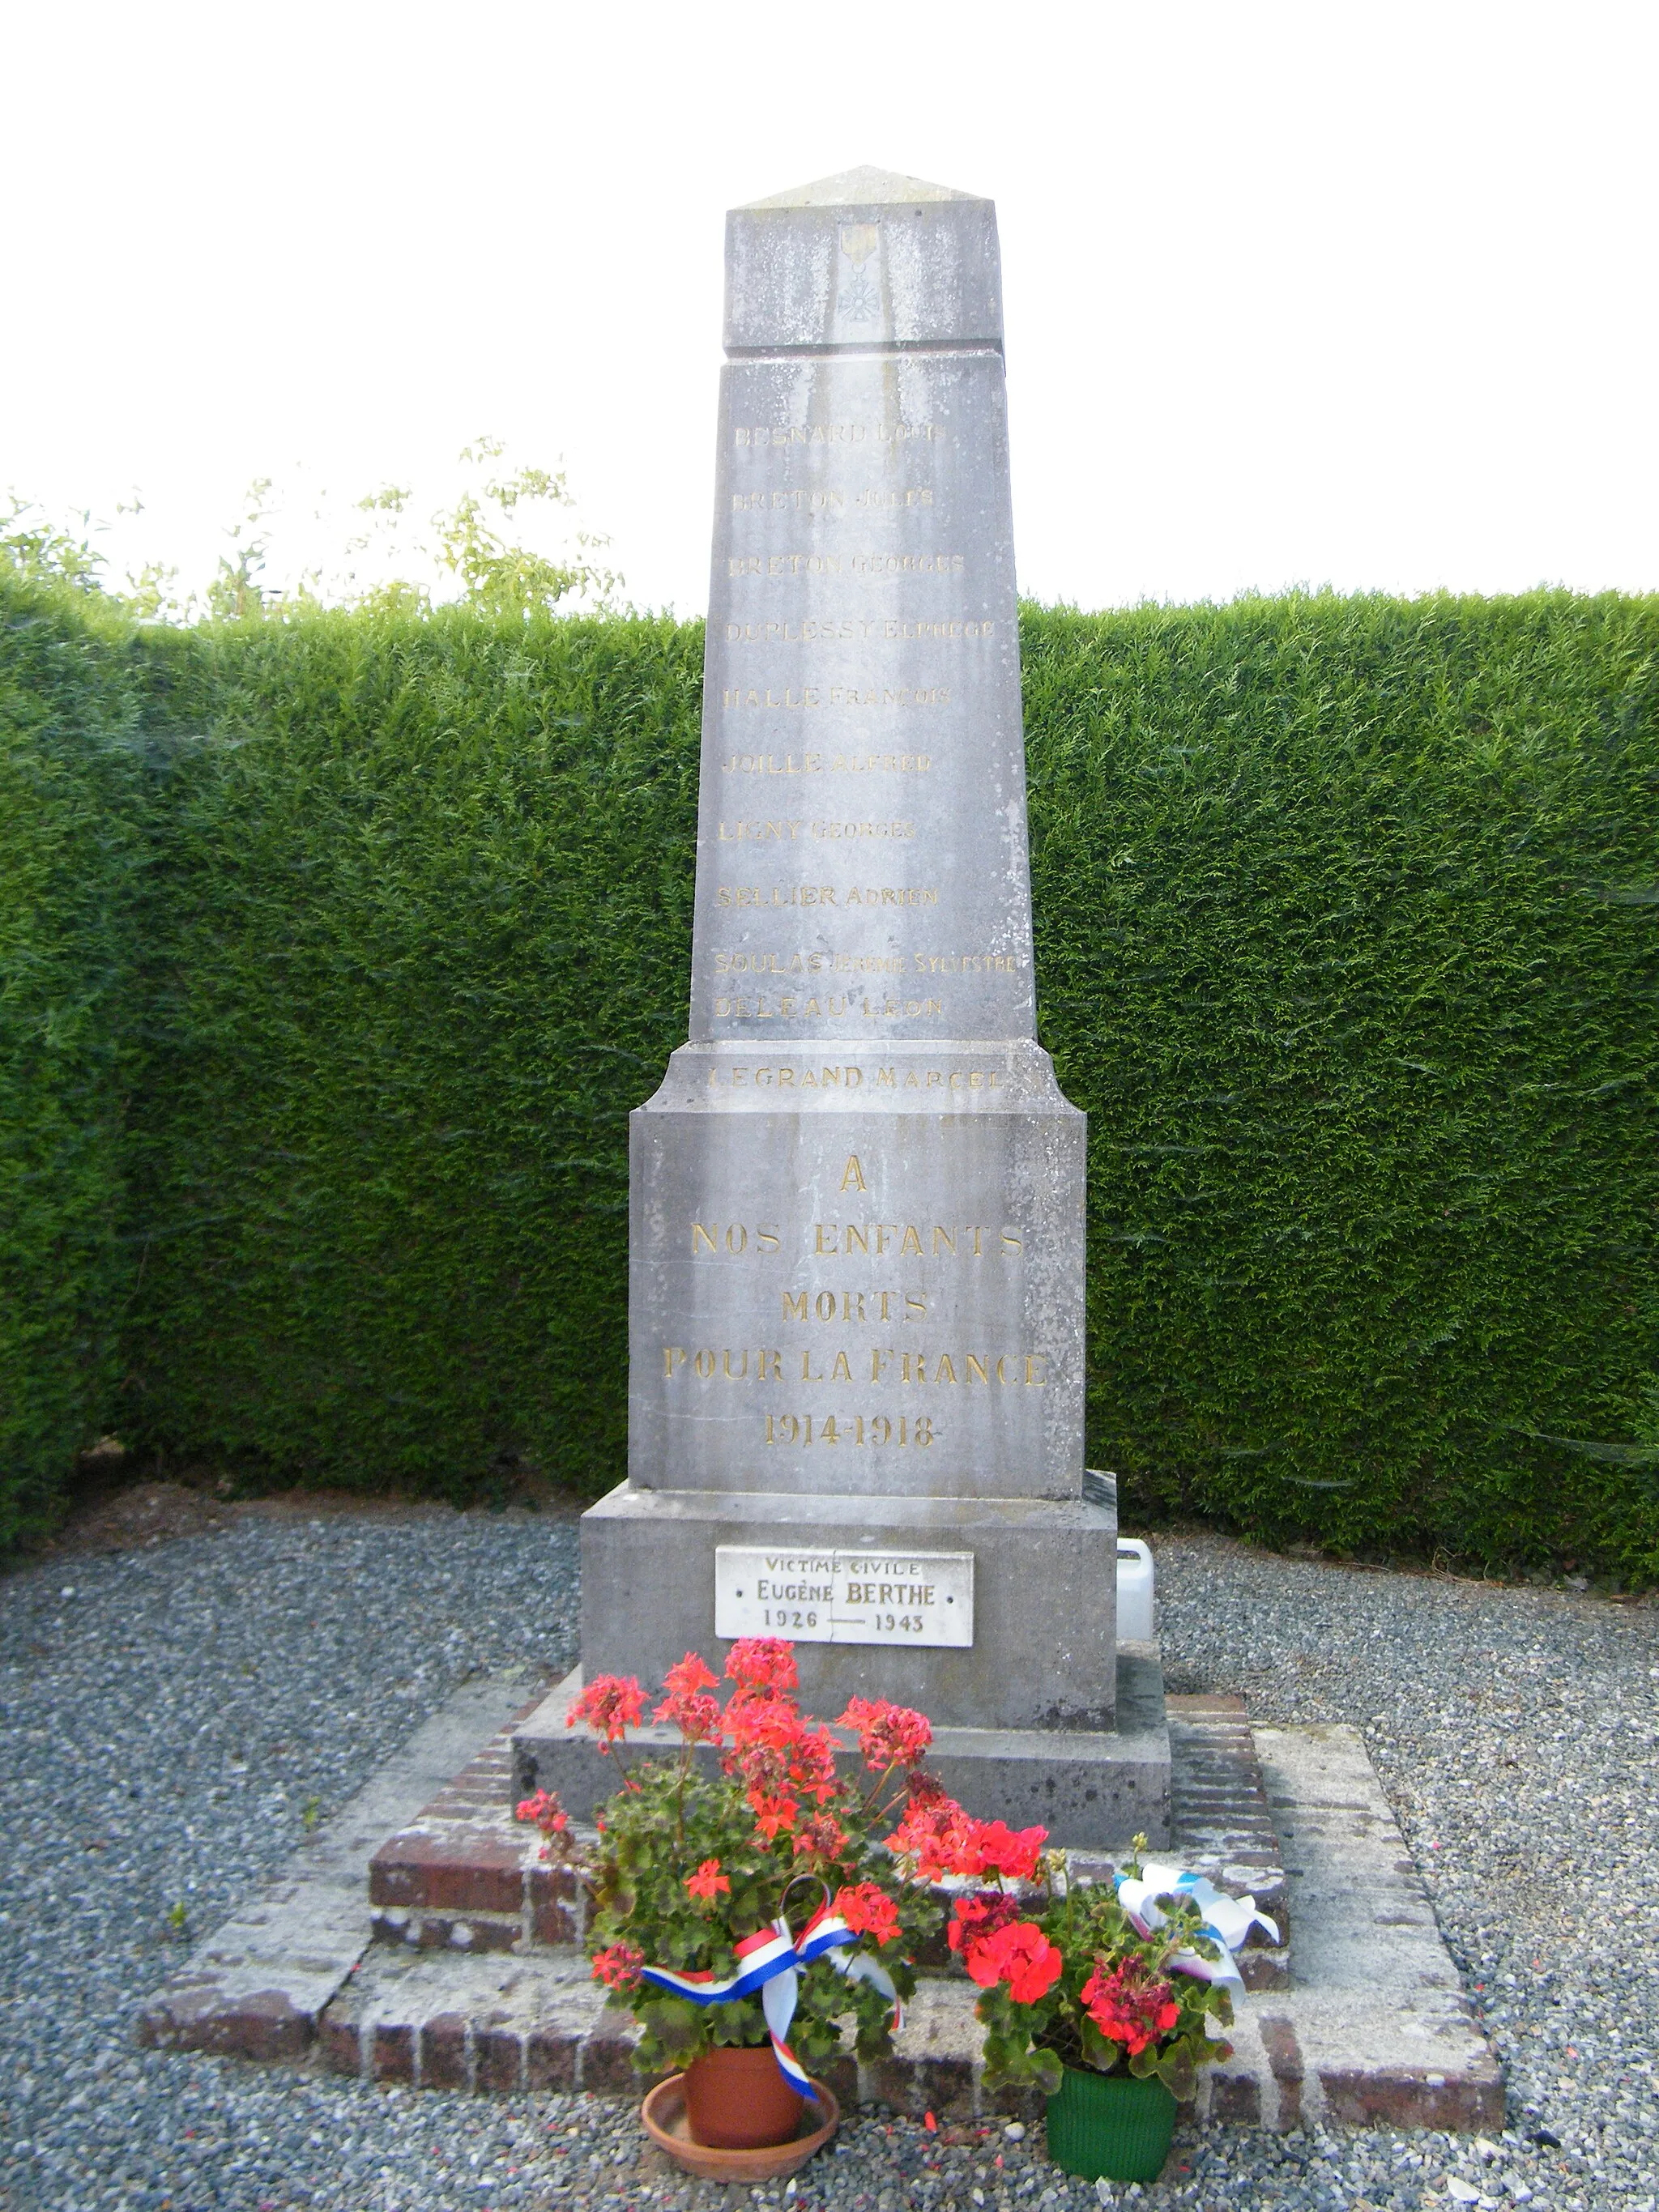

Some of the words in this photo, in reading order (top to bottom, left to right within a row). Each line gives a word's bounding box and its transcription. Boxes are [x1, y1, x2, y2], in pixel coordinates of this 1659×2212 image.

[732, 490, 845, 511] BRETON
[855, 489, 934, 507] JULES
[729, 556, 842, 576] BRETON
[851, 556, 964, 574] GEORGES
[726, 621, 875, 641] DUPLESSY
[723, 688, 820, 707] HALLE
[722, 753, 821, 774] JOILLE
[831, 754, 930, 772] ALFRED
[719, 821, 803, 842] LIGNY
[811, 822, 916, 840] GEORGES
[717, 888, 836, 907] SELLIER
[847, 887, 937, 906] ADRIEN
[714, 954, 821, 974] SOULAS
[915, 953, 1016, 974] SYLVESTRE
[715, 998, 847, 1018] DELEAU
[708, 1068, 863, 1088] LEGRAND
[876, 1068, 1004, 1089] MARCEL
[839, 1155, 868, 1192] A
[691, 1223, 781, 1255] NOS
[815, 1225, 1023, 1256] ENFANTS
[782, 1290, 928, 1322] MORTS
[663, 1348, 783, 1381] POUR
[801, 1350, 853, 1382] LA
[870, 1349, 1049, 1387] FRANCE
[765, 1414, 934, 1447] 1914-1918
[766, 1558, 841, 1573] VICTIME
[851, 1562, 919, 1575] CIVILE
[846, 1583, 935, 1605] BERTHE
[764, 1609, 817, 1628] 1926
[876, 1613, 923, 1633] 1943
